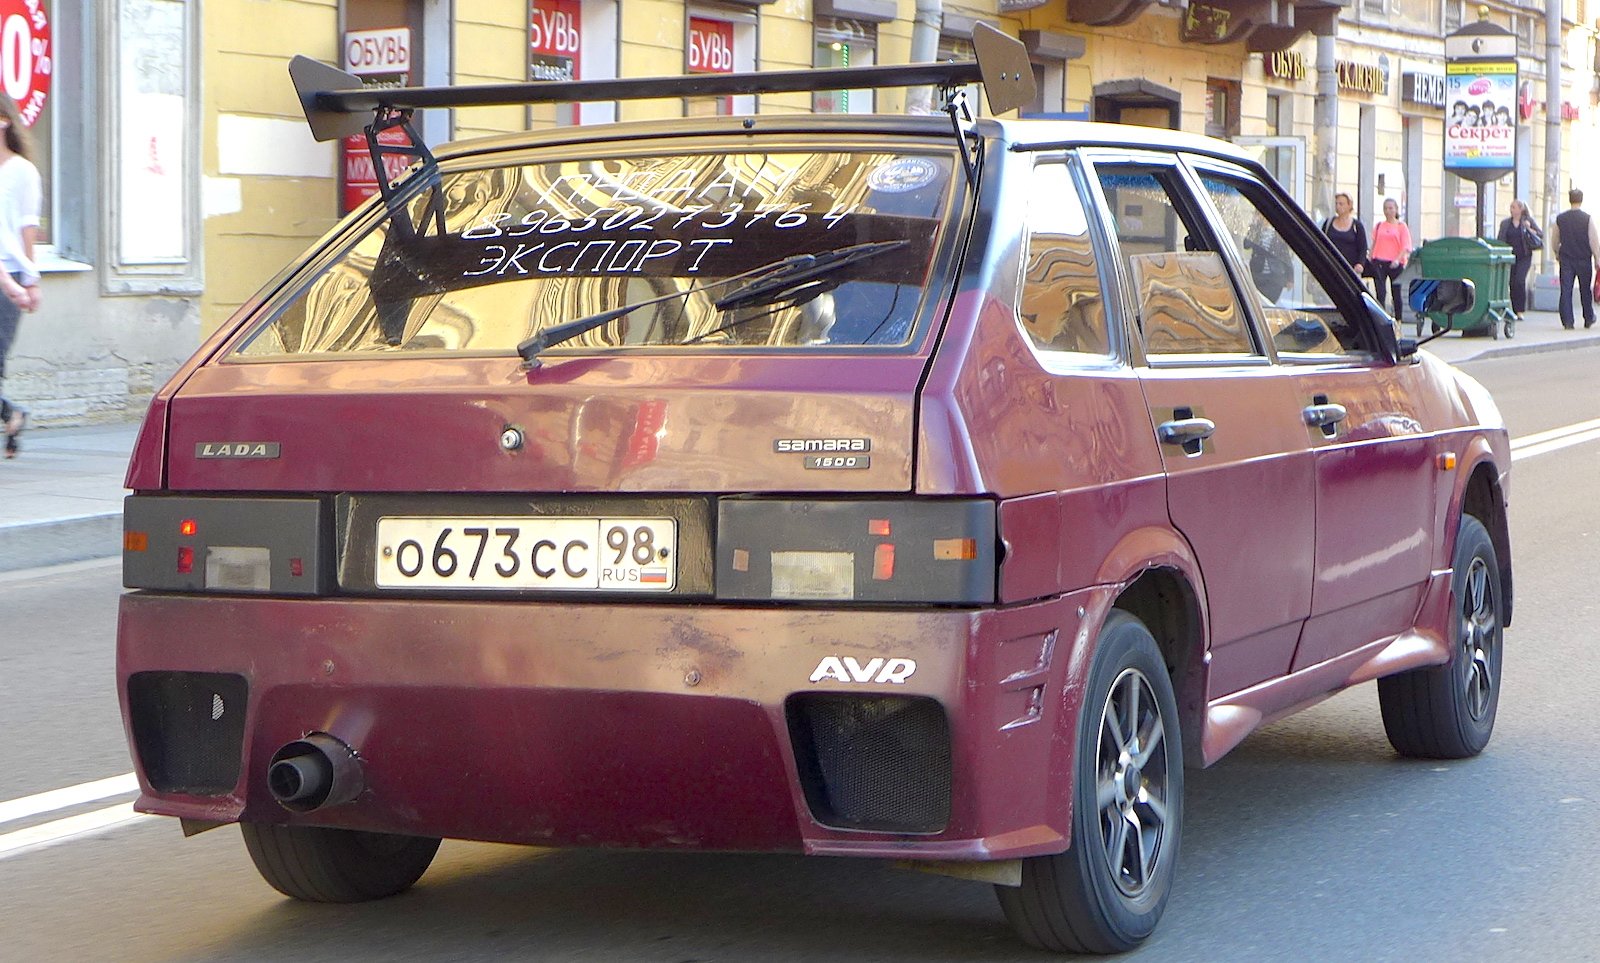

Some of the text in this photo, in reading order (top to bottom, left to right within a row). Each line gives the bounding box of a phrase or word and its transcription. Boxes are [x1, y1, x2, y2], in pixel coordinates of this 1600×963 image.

[348, 35, 407, 67] ОБУВЬ
[1271, 50, 1307, 80] ОБУВЬ
[1336, 60, 1385, 95] СКЛЮЗИВ
[1448, 124, 1512, 142] Секрет
[463, 238, 733, 276] ЭКСПОРТ
[202, 444, 267, 456] LADA
[606, 525, 655, 566] 98
[602, 568, 638, 582] RUS
[809, 656, 917, 684] AVR
